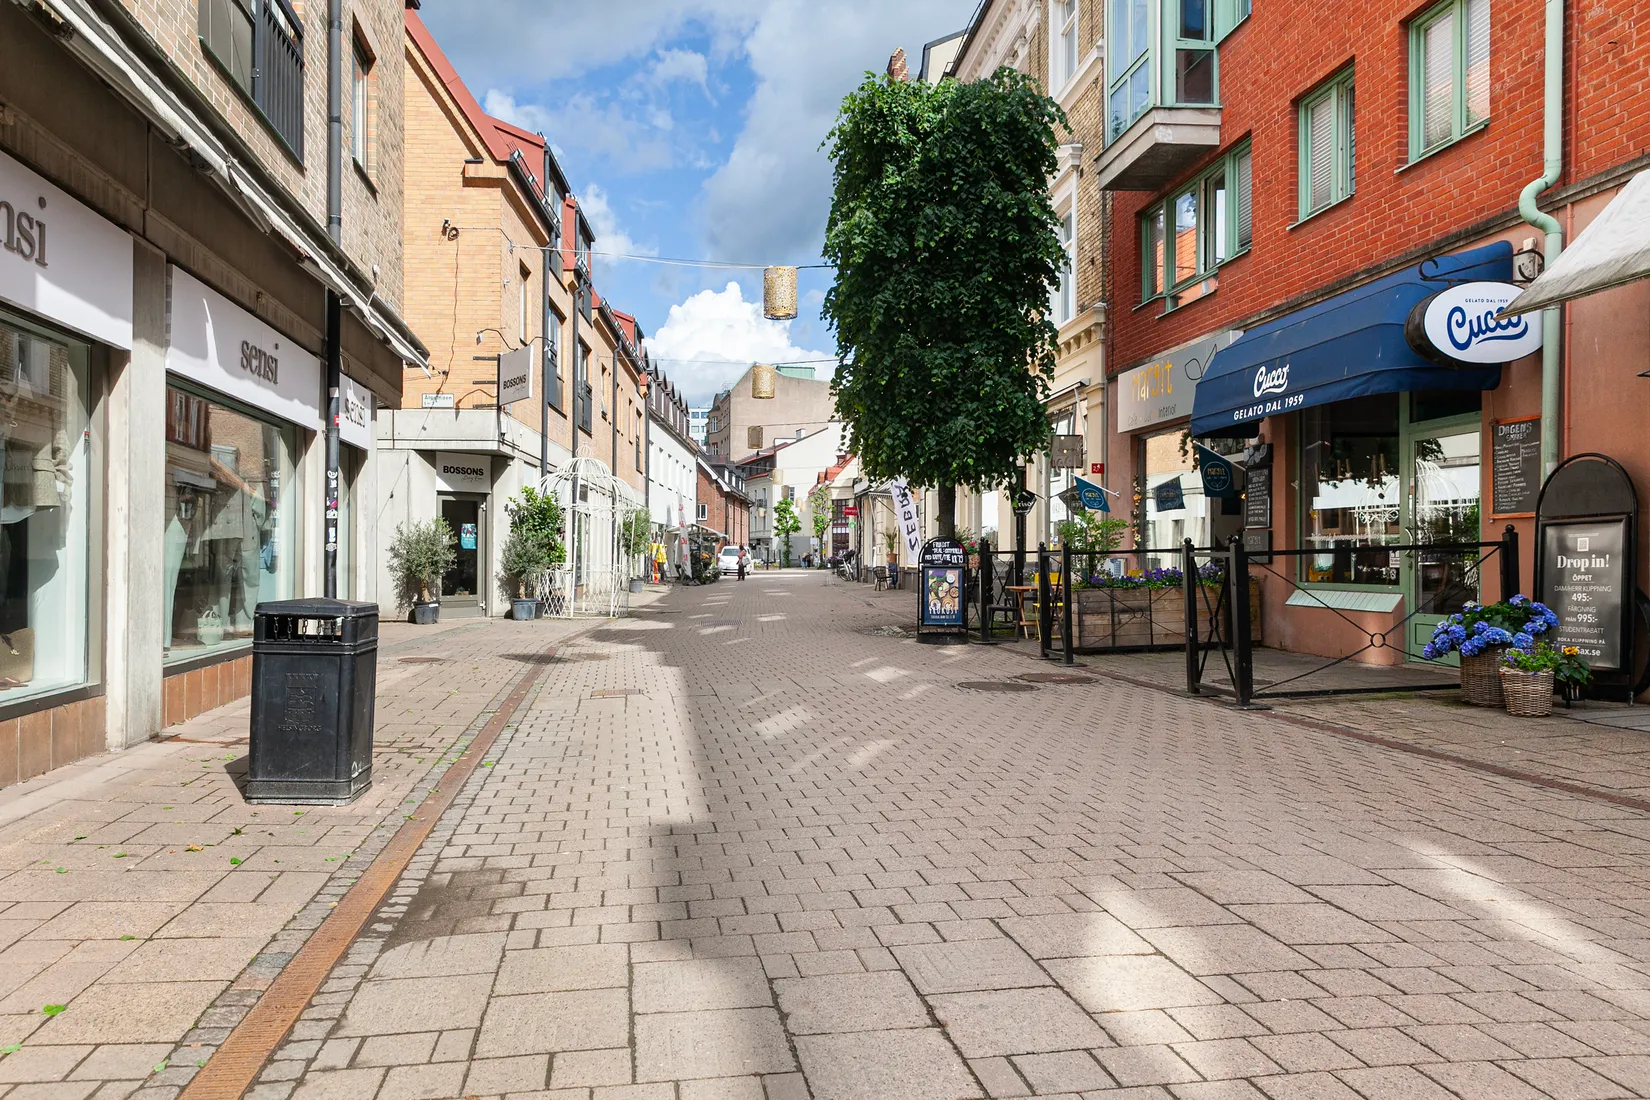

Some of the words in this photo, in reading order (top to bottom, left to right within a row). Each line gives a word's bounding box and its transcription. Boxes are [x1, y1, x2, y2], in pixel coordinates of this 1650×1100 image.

[1447, 306, 1528, 351] Cucco
[241, 340, 280, 386] sensi
[503, 374, 527, 390] BOSSONS
[1253, 364, 1289, 398] Cucco
[344, 395, 366, 429] sensi
[1234, 404, 1264, 420] GELATO
[1265, 400, 1282, 412] DAL
[1284, 394, 1304, 408] 1959
[1498, 422, 1532, 437] DAGENS
[443, 466, 484, 476] BOSSONS
[1557, 556, 1590, 572] Drop
[1591, 554, 1610, 568] in!
[1572, 592, 1592, 602] 495:-
[1568, 604, 1596, 612] FÄRGNING
[1577, 614, 1598, 622] 995:-
